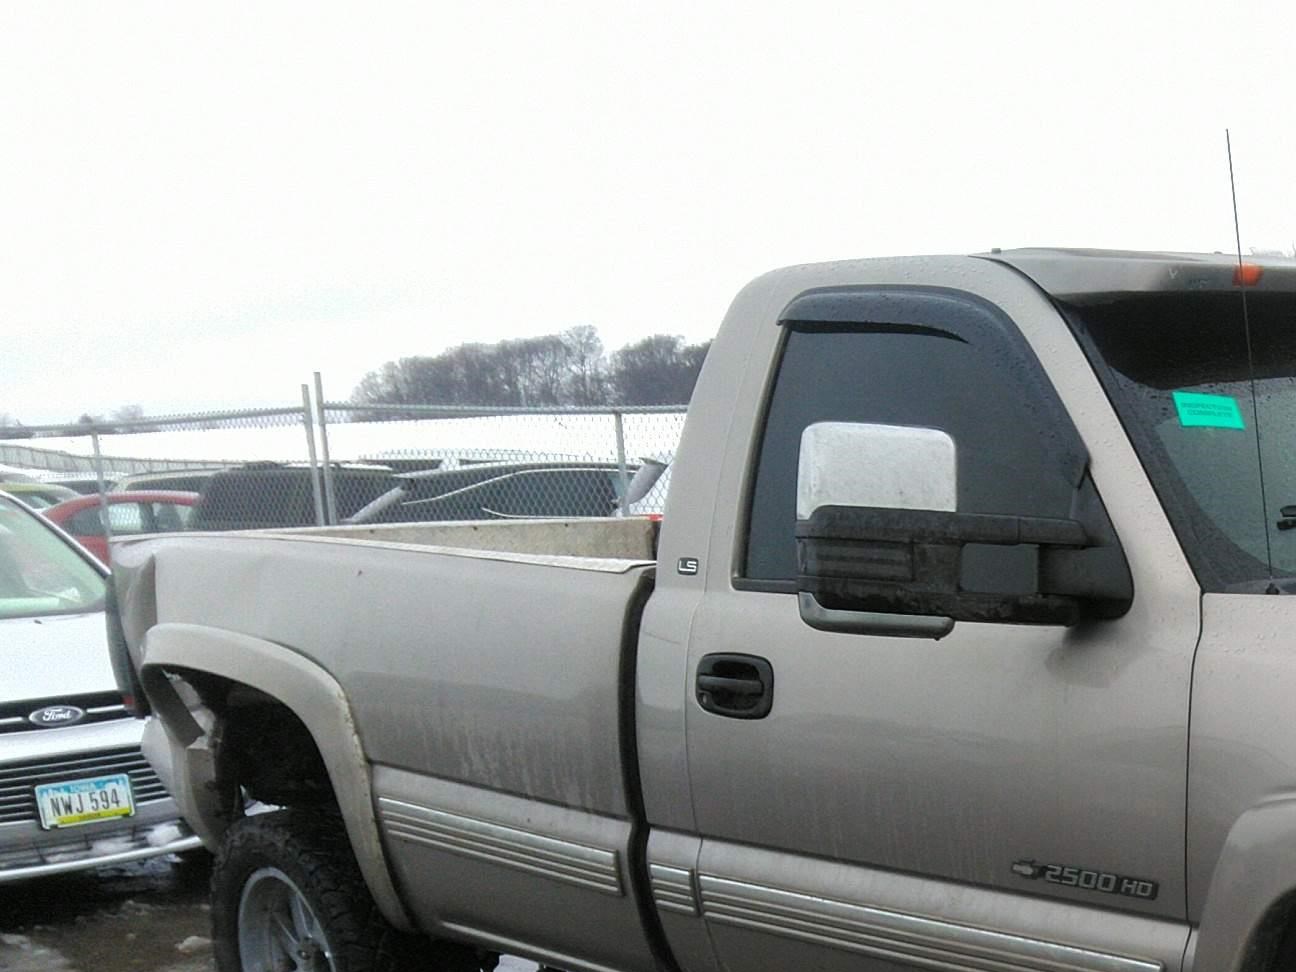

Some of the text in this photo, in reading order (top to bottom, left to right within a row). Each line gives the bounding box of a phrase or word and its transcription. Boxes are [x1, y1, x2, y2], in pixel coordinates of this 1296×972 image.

[678, 559, 697, 572] LS
[42, 708, 73, 721] Ford
[50, 788, 120, 817] NWJ 594
[1045, 864, 1153, 897] 2500 HD
